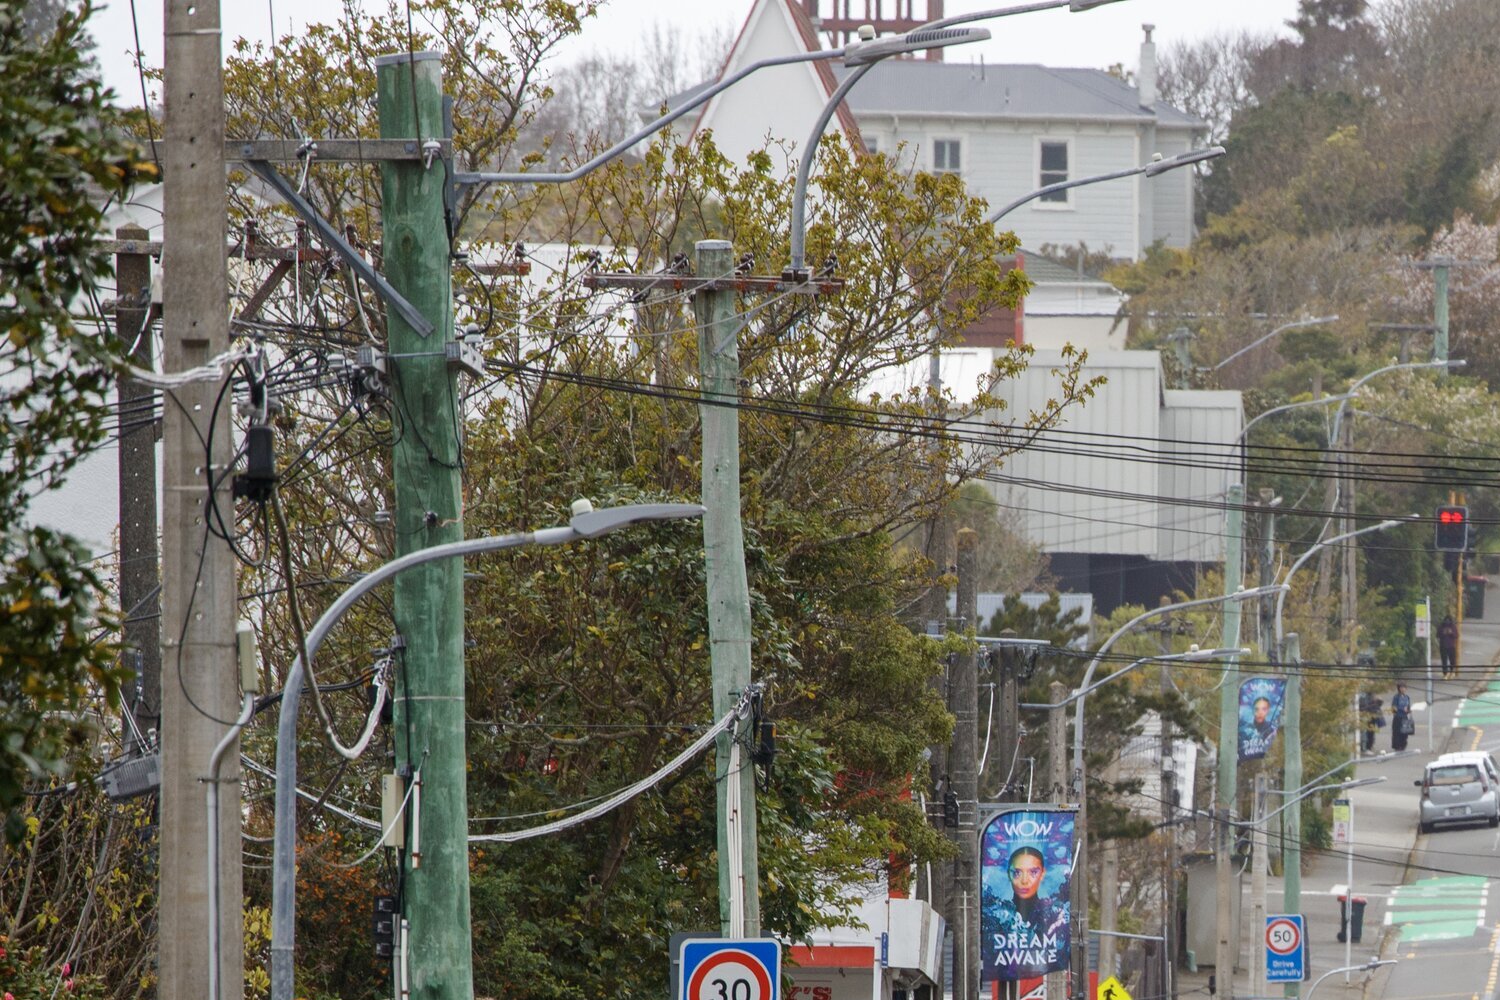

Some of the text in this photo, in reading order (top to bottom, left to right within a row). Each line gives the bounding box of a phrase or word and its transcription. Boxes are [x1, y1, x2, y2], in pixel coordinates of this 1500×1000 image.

[1004, 820, 1053, 837] WOW
[994, 933, 1057, 949] DREAM
[1274, 930, 1292, 943] 50
[994, 949, 1057, 966] AWAKE
[1272, 960, 1295, 968] Drive
